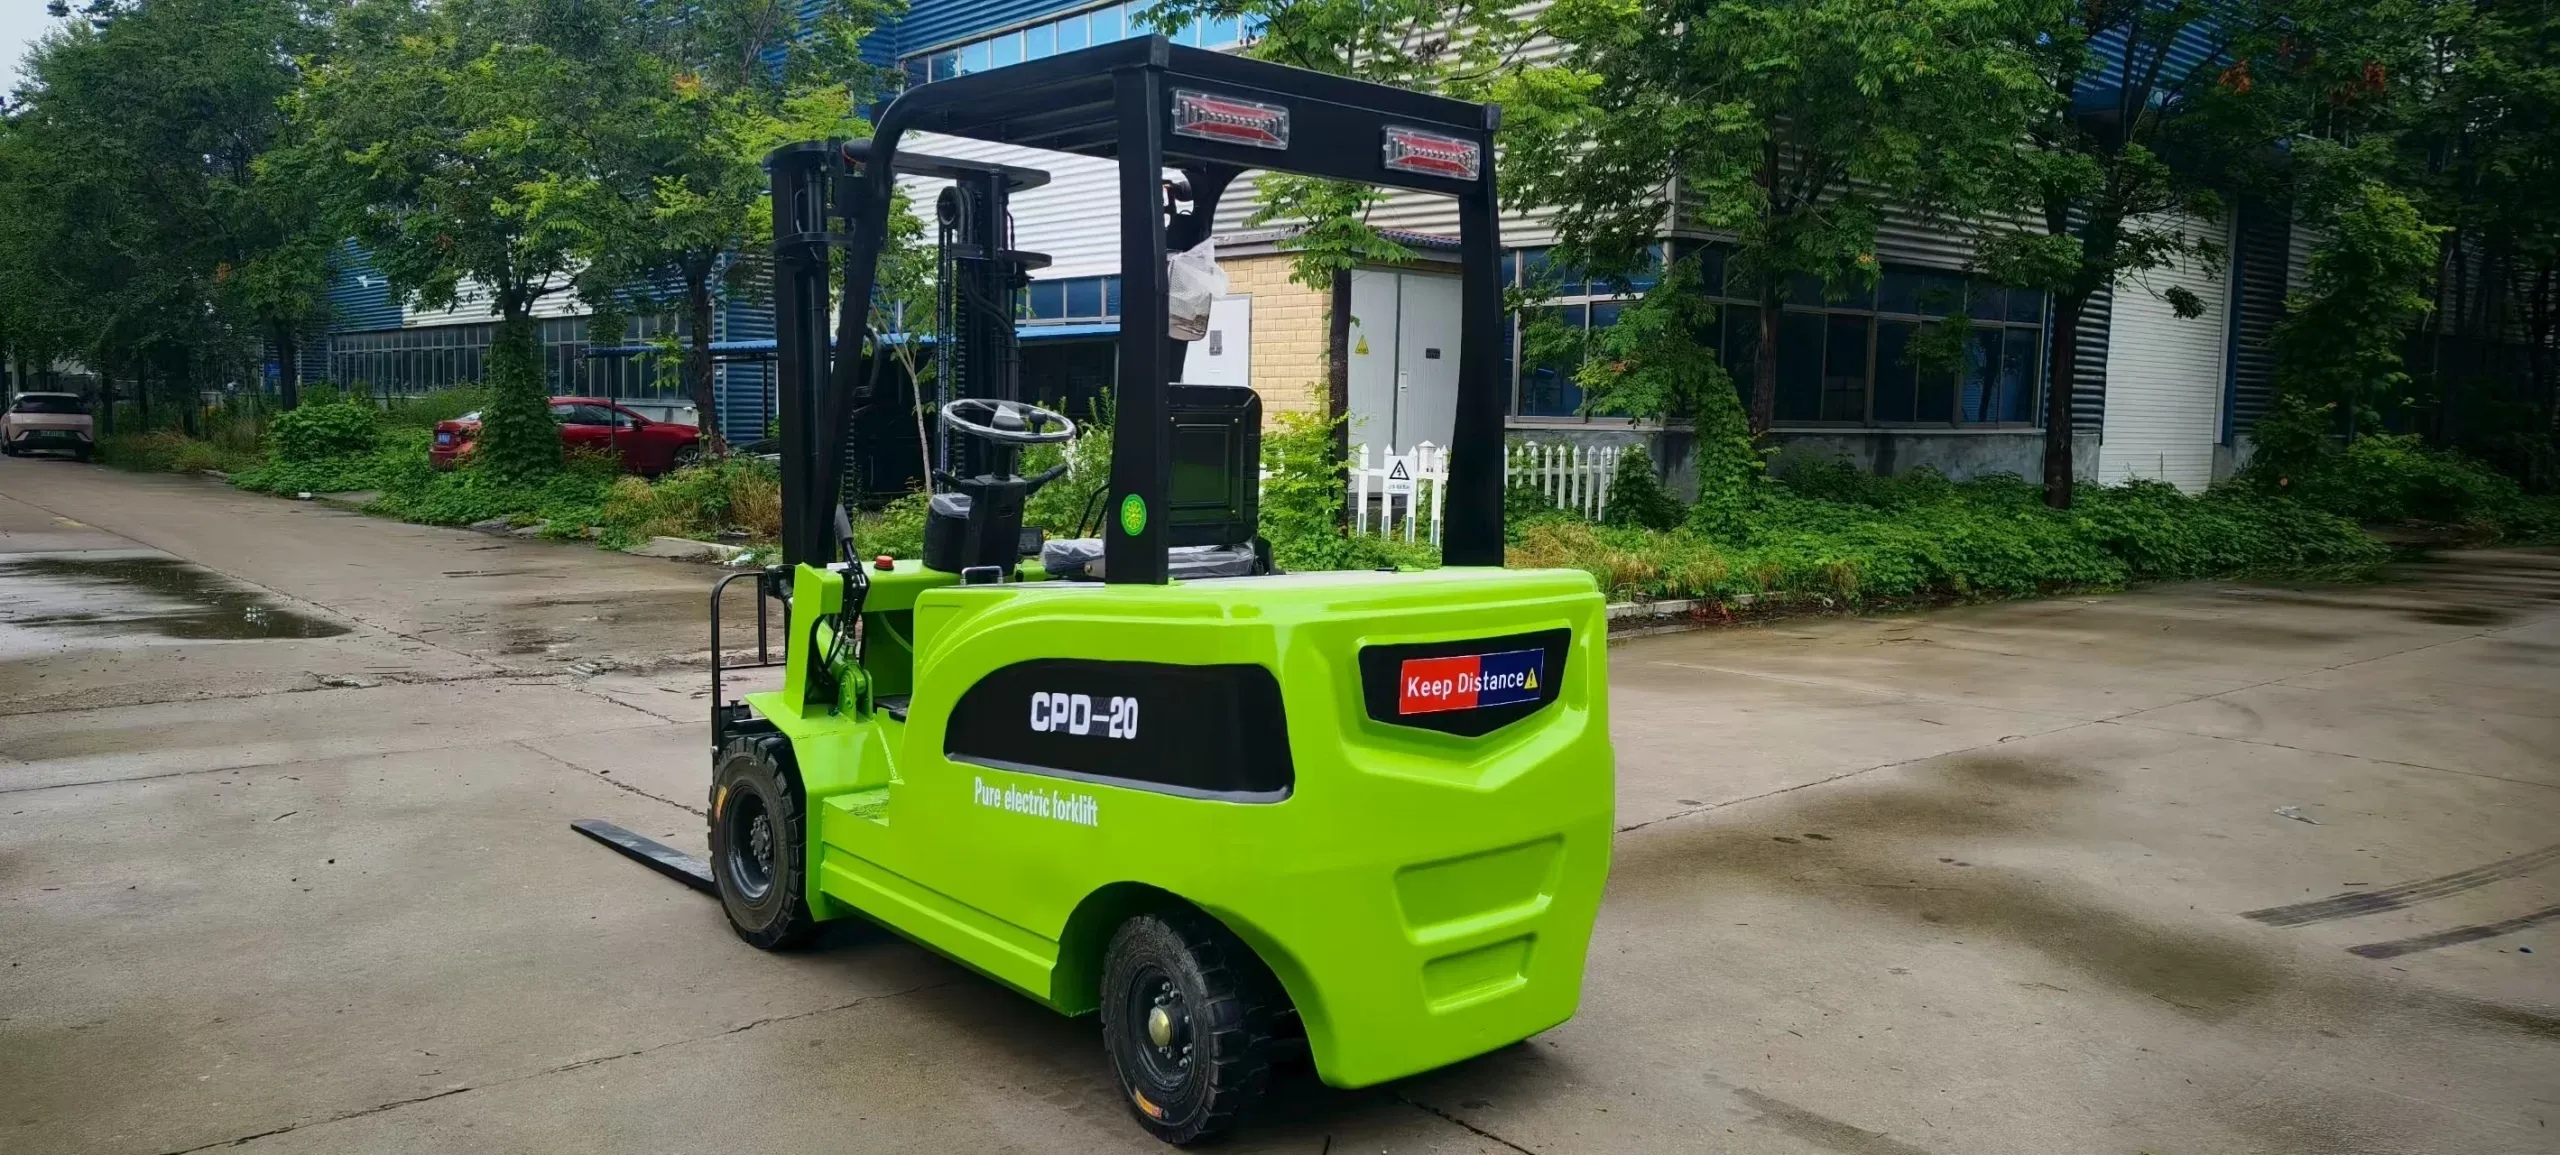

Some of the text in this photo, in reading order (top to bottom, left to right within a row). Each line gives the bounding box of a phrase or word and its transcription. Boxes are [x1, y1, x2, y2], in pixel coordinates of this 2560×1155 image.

[1407, 671, 1524, 700] Keep Distance
[1030, 691, 1138, 739] CPD-20
[974, 776, 1098, 826] Pure electric forklift
